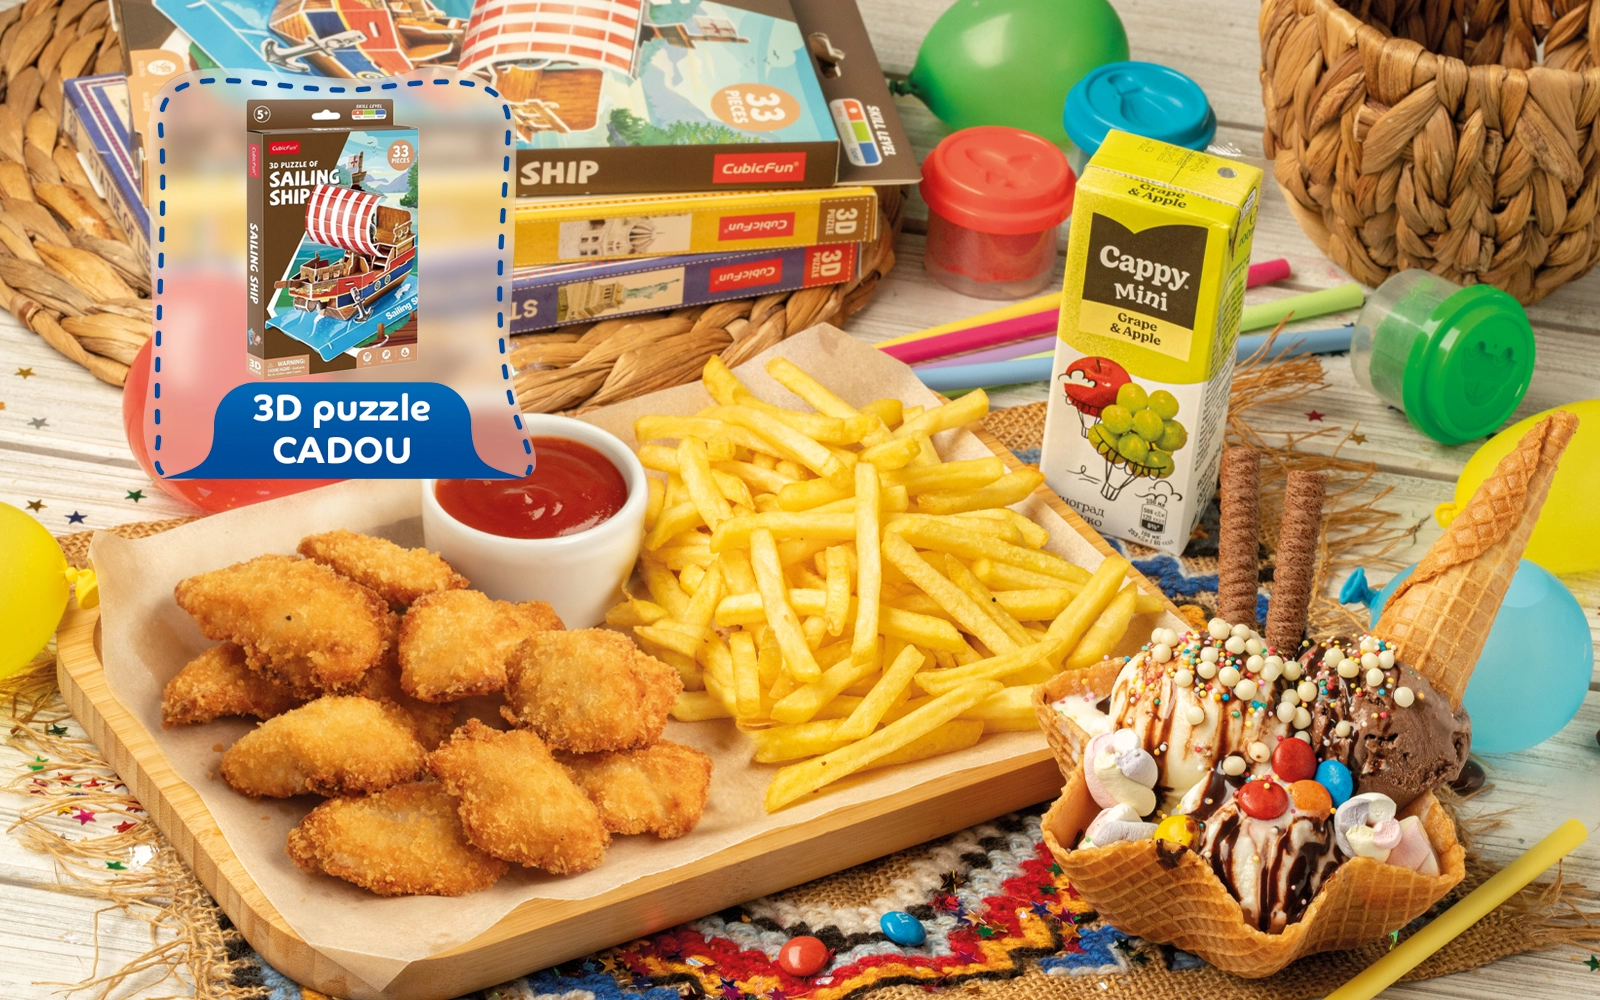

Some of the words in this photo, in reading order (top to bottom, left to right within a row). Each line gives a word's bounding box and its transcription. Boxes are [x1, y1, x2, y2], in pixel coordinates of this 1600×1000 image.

[256, 109, 269, 120] 5+
[725, 90, 748, 124] PIECES
[745, 92, 786, 122] 33
[866, 105, 886, 129] SKILL
[876, 130, 896, 156] LEVEL
[392, 144, 409, 158] 33
[269, 169, 340, 188] SAILING
[520, 160, 599, 186] SHIP
[269, 188, 311, 206] SHIP
[1128, 188, 1140, 196] &
[1141, 192, 1187, 208] Apple
[1140, 184, 1186, 198] Grape
[825, 209, 836, 235] PUZZLE
[835, 208, 858, 235] 3D
[249, 223, 258, 272] SAILING
[811, 252, 821, 278] PUZZLE
[820, 250, 842, 277] 3D
[1100, 245, 1190, 292] Cappy
[249, 275, 258, 304] SHIP
[1114, 283, 1168, 312] Mini
[385, 302, 413, 320] Sailing
[1117, 312, 1158, 332] Grape
[1110, 323, 1121, 334] &
[1122, 327, 1161, 346] Apple
[249, 359, 261, 370] 3D
[277, 358, 306, 367] WARNING:
[1059, 495, 1105, 518] ноград
